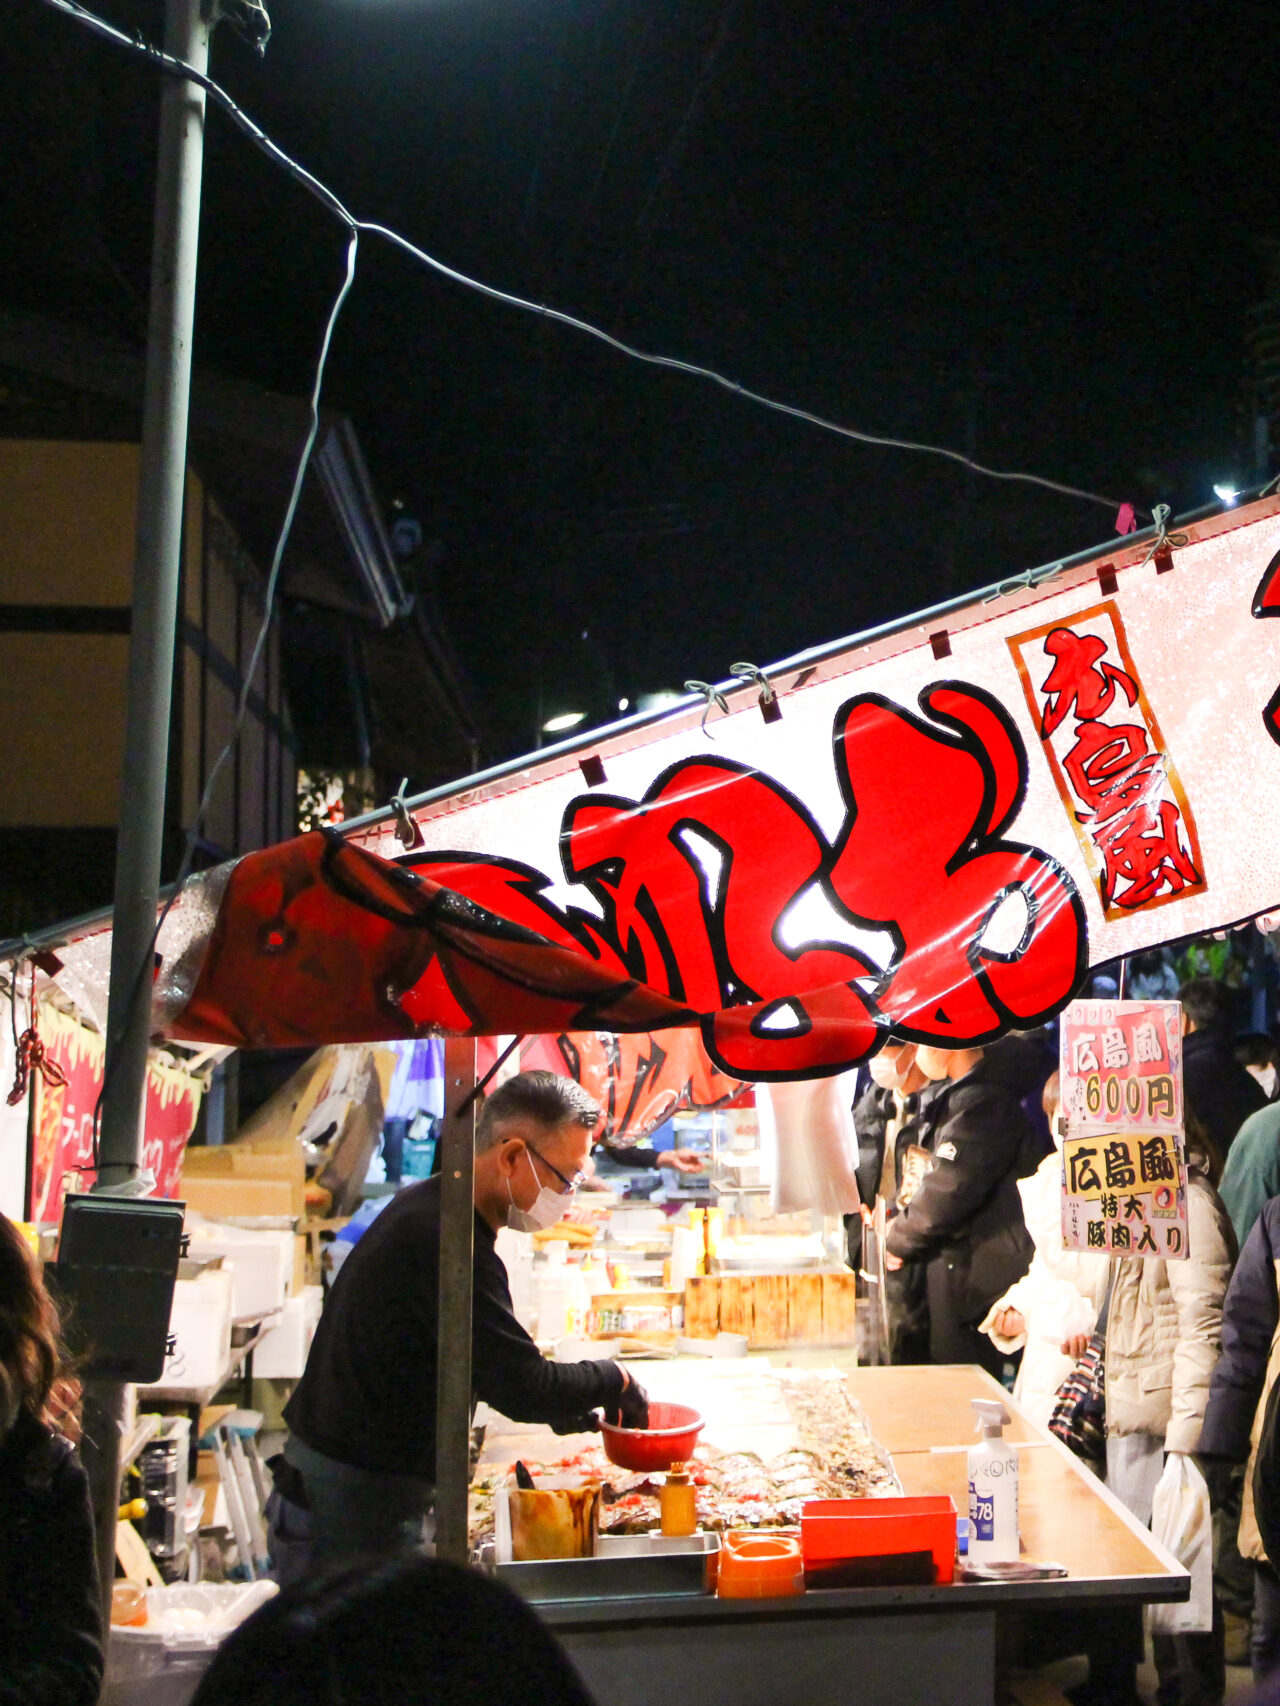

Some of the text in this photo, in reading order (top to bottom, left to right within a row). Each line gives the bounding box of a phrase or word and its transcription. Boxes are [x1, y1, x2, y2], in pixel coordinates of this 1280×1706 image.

[1072, 1022, 1163, 1074] 広島風
[1086, 1073, 1175, 1118] 600円
[1069, 1136, 1175, 1194] 広島風
[1100, 1192, 1144, 1221] 特大
[1087, 1220, 1182, 1254] 豚肉入り
